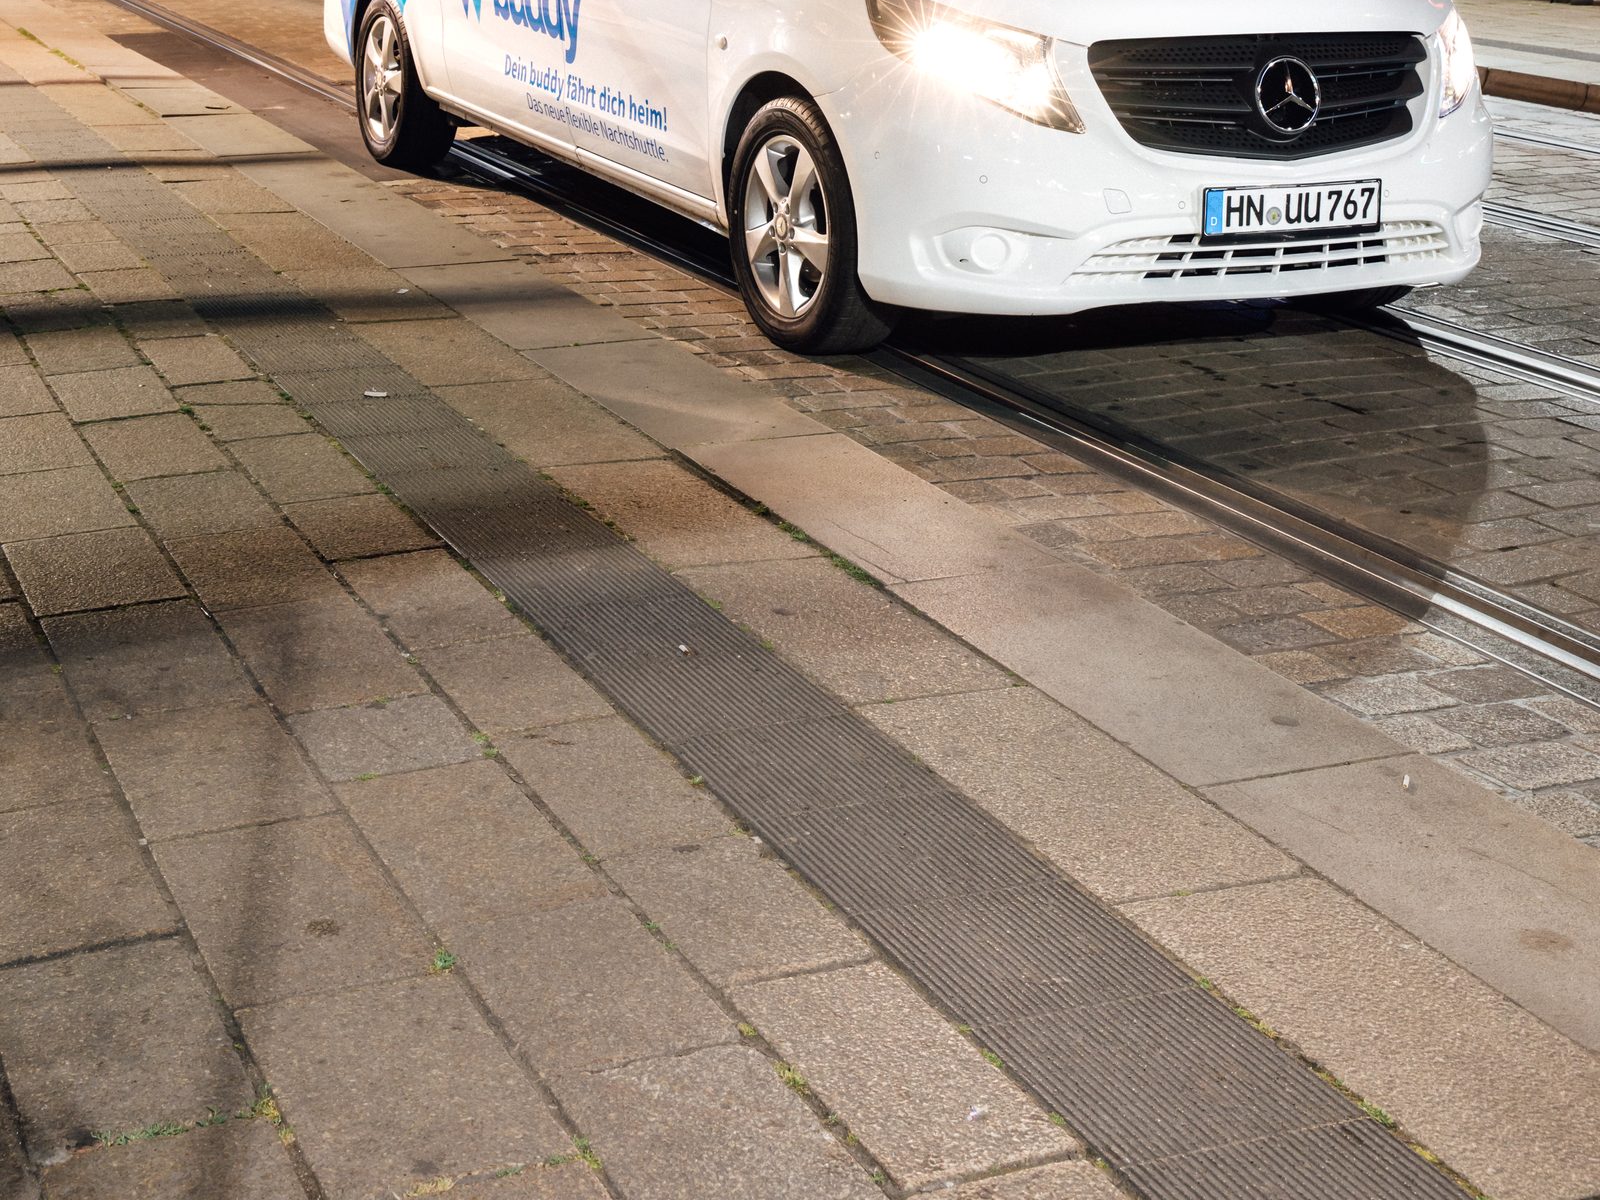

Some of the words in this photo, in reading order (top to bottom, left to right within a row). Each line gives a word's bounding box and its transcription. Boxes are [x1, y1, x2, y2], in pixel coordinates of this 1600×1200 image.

[504, 54, 527, 82] Dein
[529, 61, 565, 101] buddy
[566, 74, 597, 108] fährt
[600, 86, 626, 118] dich
[629, 94, 668, 132] heim!
[526, 92, 544, 113] Das
[544, 104, 566, 123] neue
[565, 106, 601, 137] flexible
[600, 120, 669, 163] Nachtshuttle.
[1226, 194, 1264, 227] HN
[1285, 191, 1322, 224] UU
[1327, 187, 1376, 221] 767
